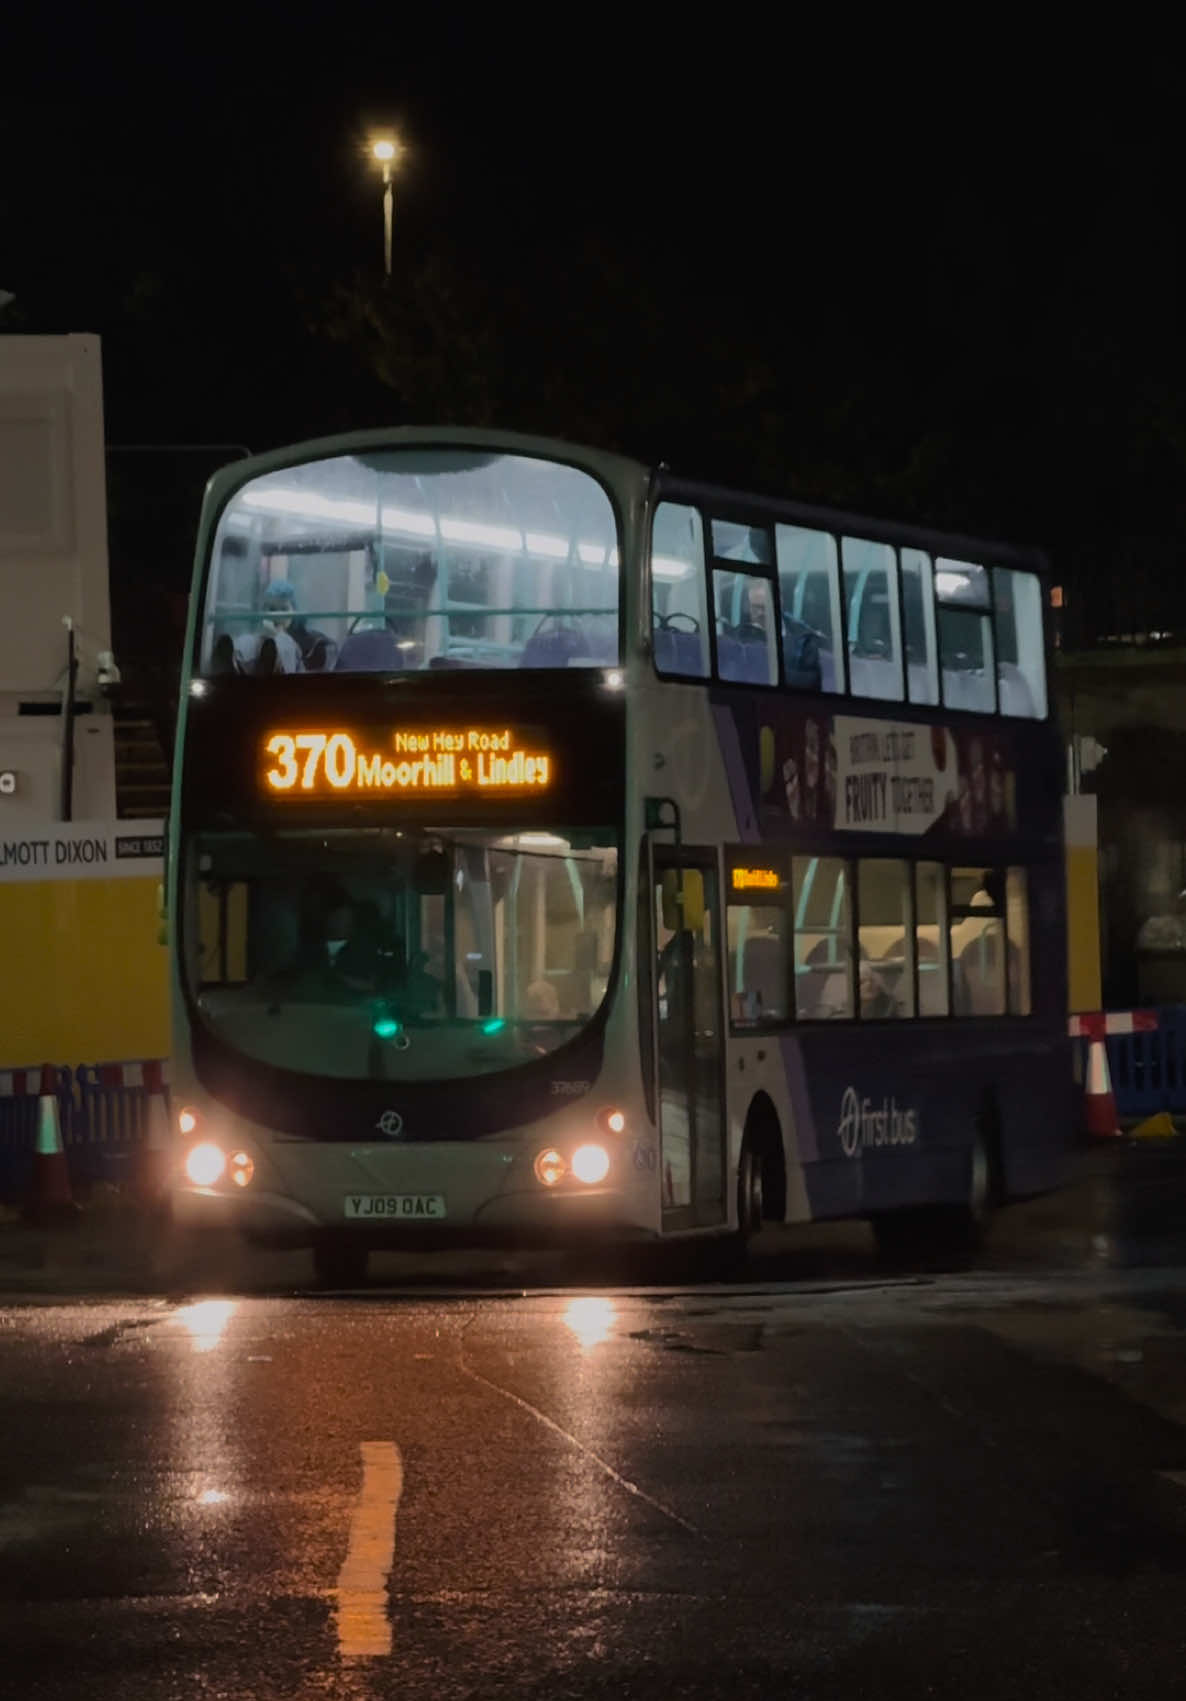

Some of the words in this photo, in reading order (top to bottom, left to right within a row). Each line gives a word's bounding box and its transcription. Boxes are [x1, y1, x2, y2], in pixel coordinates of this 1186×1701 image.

[395, 731, 430, 752] New
[433, 731, 465, 751] Hey
[468, 729, 510, 751] Road
[266, 733, 356, 789] 370
[356, 754, 456, 787] Moorhill
[459, 757, 473, 781] &
[477, 751, 549, 786] Lindley
[845, 772, 887, 823] FRUITY
[55, 839, 107, 864] DIXON
[351, 1199, 398, 1216] YJ09
